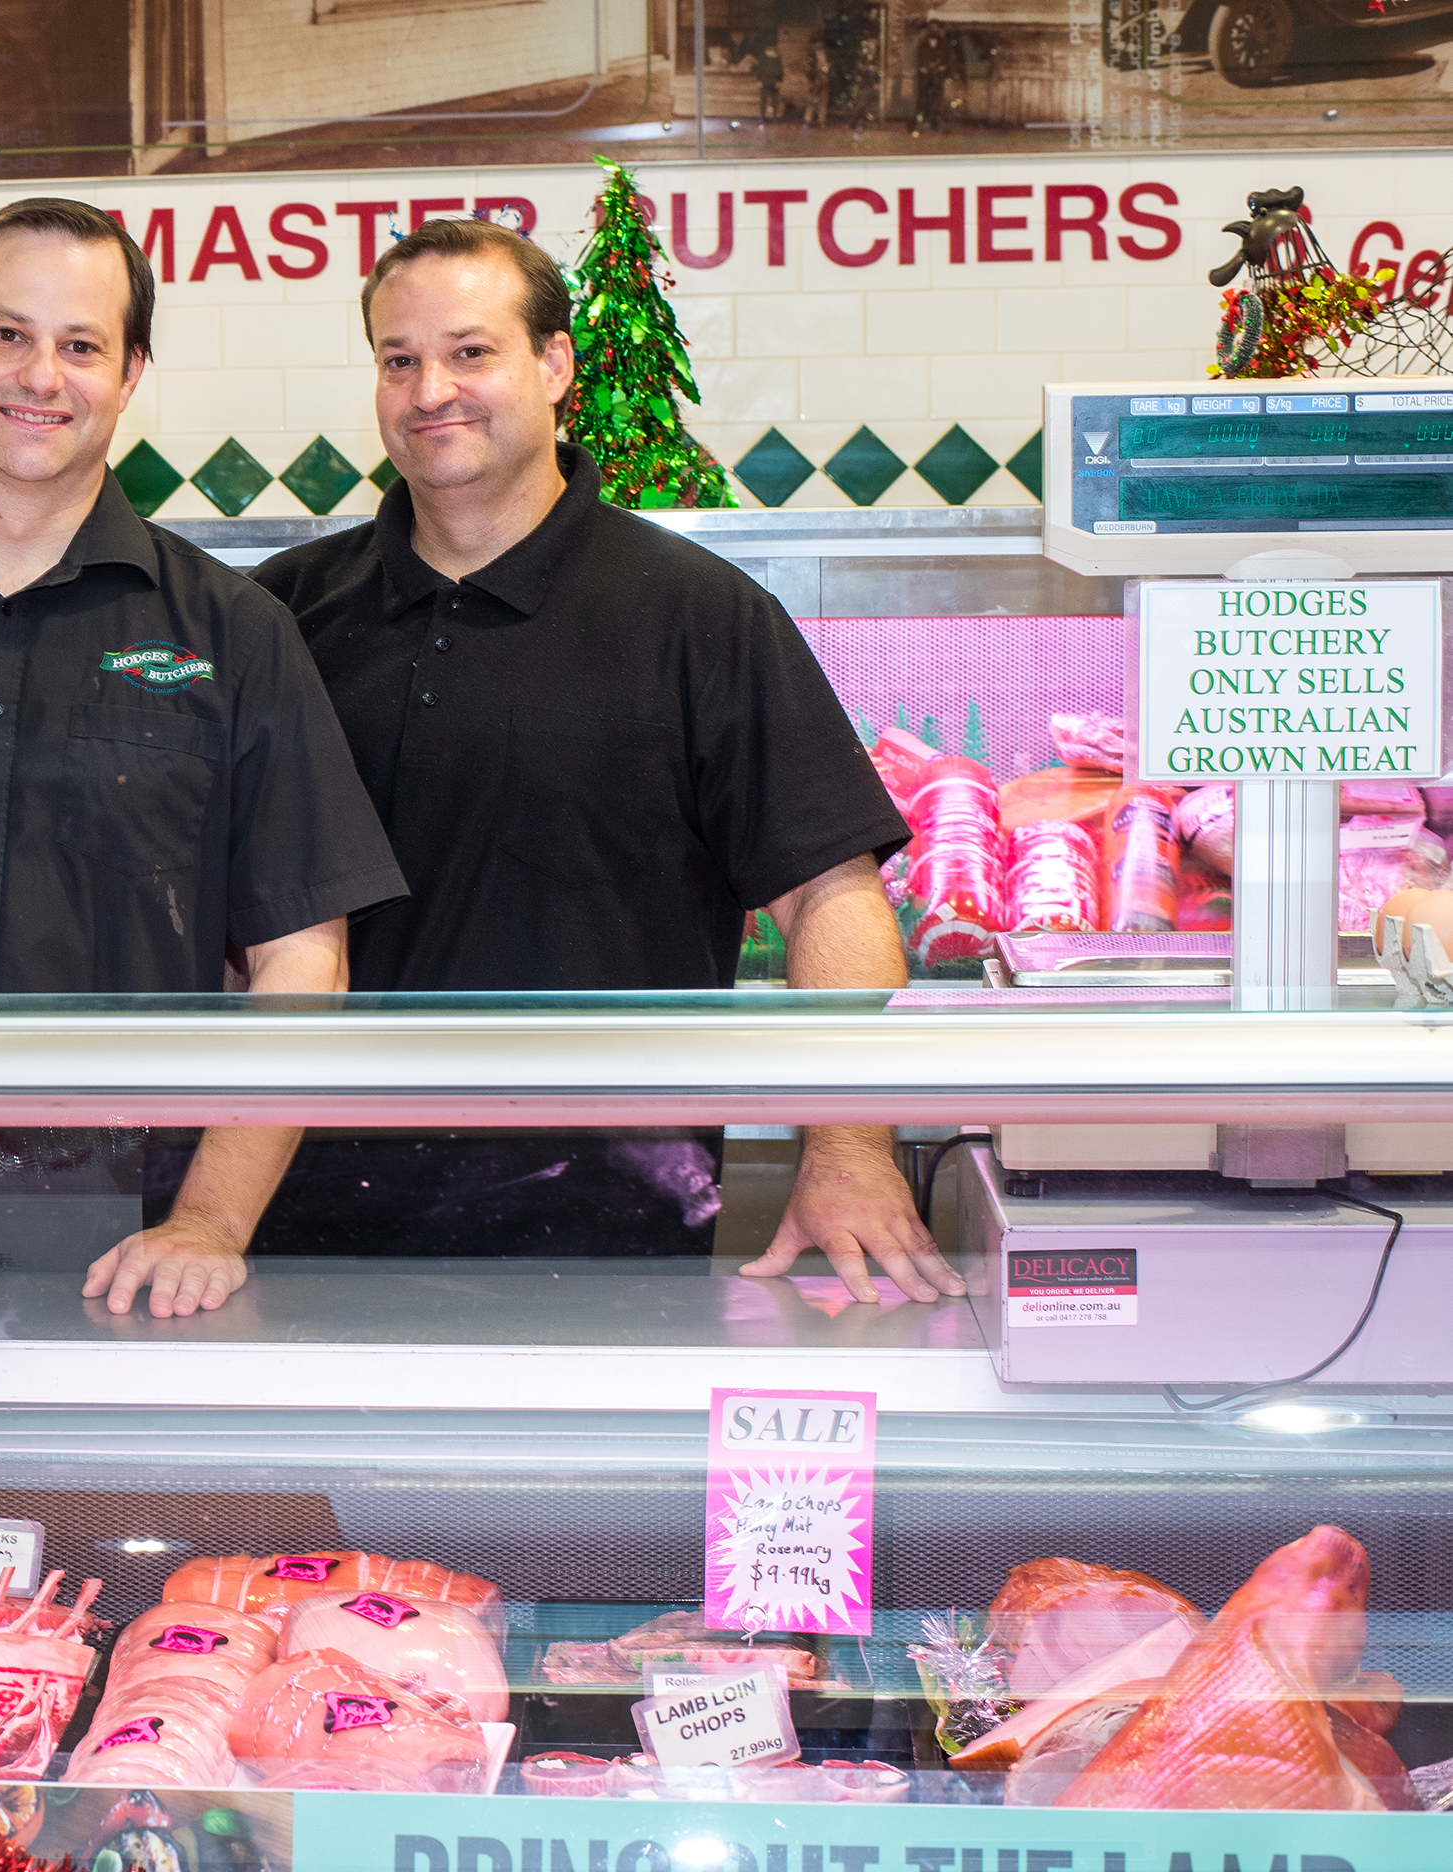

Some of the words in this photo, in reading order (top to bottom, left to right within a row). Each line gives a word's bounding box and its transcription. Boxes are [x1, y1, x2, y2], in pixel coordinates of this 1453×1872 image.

[1133, 401, 1159, 412] TARE
[1167, 400, 1181, 413] kg
[1193, 399, 1233, 411] WEIGHT
[1242, 398, 1256, 411] kg
[1267, 397, 1292, 411] $/kg
[1311, 397, 1342, 409] PRICE
[1356, 397, 1364, 407] $
[1390, 395, 1422, 407] TOTAL
[1423, 394, 1453, 406] PRICE
[1133, 428, 1157, 444] 0.0
[1207, 423, 1260, 443] 0.000
[1085, 456, 1107, 465] DIGI
[1147, 487, 1198, 509] HAVE
[1210, 486, 1225, 508] A
[1238, 484, 1302, 507] GREAT
[1096, 523, 1154, 533] WEDDERBURN
[1217, 588, 1368, 617] HODGES
[1192, 627, 1392, 656] BUTCHERY
[111, 651, 170, 669] HODGES
[147, 661, 213, 682] BUTCHERY
[1189, 667, 1288, 695] ONLY
[1297, 666, 1405, 694] SELLS
[1172, 705, 1412, 734] AUSTRALIAN
[1166, 745, 1307, 773] GROWN
[1316, 744, 1417, 771] MEAT
[1013, 1256, 1131, 1277] DELICACY
[1021, 1301, 1121, 1312] delionline.com.au
[1059, 1313, 1077, 1321] 0417
[1078, 1313, 1092, 1321] 278
[1093, 1313, 1107, 1321] 788
[726, 1404, 860, 1444] SALE
[782, 1515, 813, 1534] Mint
[756, 1542, 832, 1564] Rosemary
[749, 1558, 831, 1595] $9.99kg
[654, 1694, 709, 1726] LAMB
[710, 1677, 759, 1707] LOIN
[678, 1706, 747, 1742] CHOPS
[729, 1735, 784, 1762] 27.99kg
